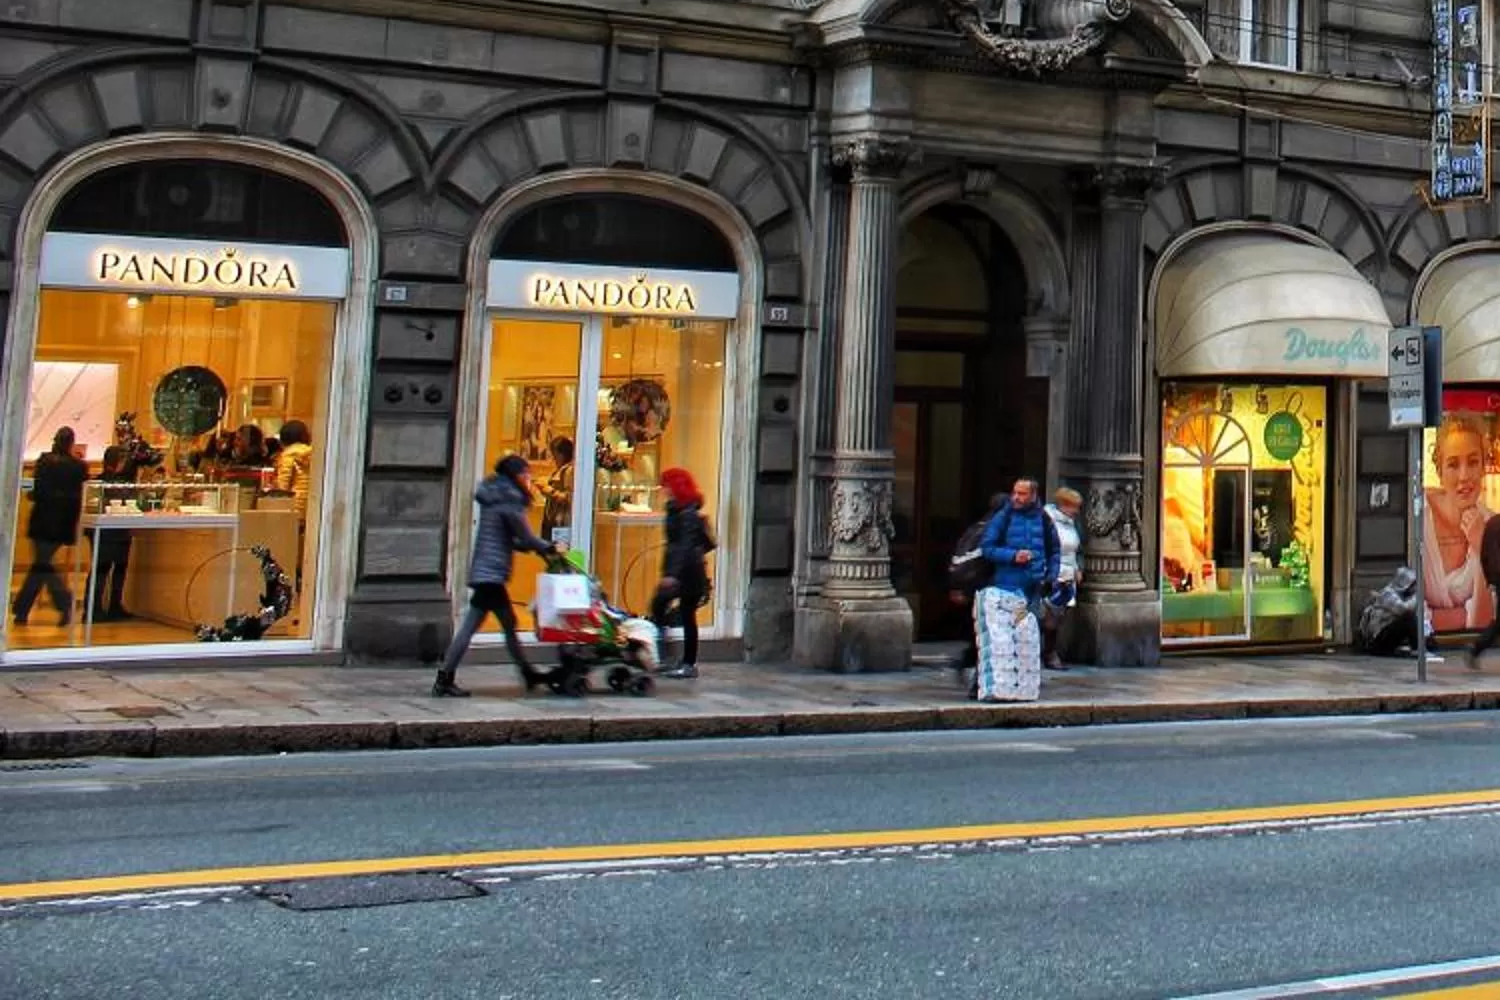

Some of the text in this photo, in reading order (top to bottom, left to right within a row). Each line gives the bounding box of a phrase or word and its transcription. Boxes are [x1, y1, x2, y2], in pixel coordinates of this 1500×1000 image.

[100, 249, 296, 289] PANDORA
[534, 272, 695, 311] PANDORA
[1282, 326, 1381, 369] Douglas
